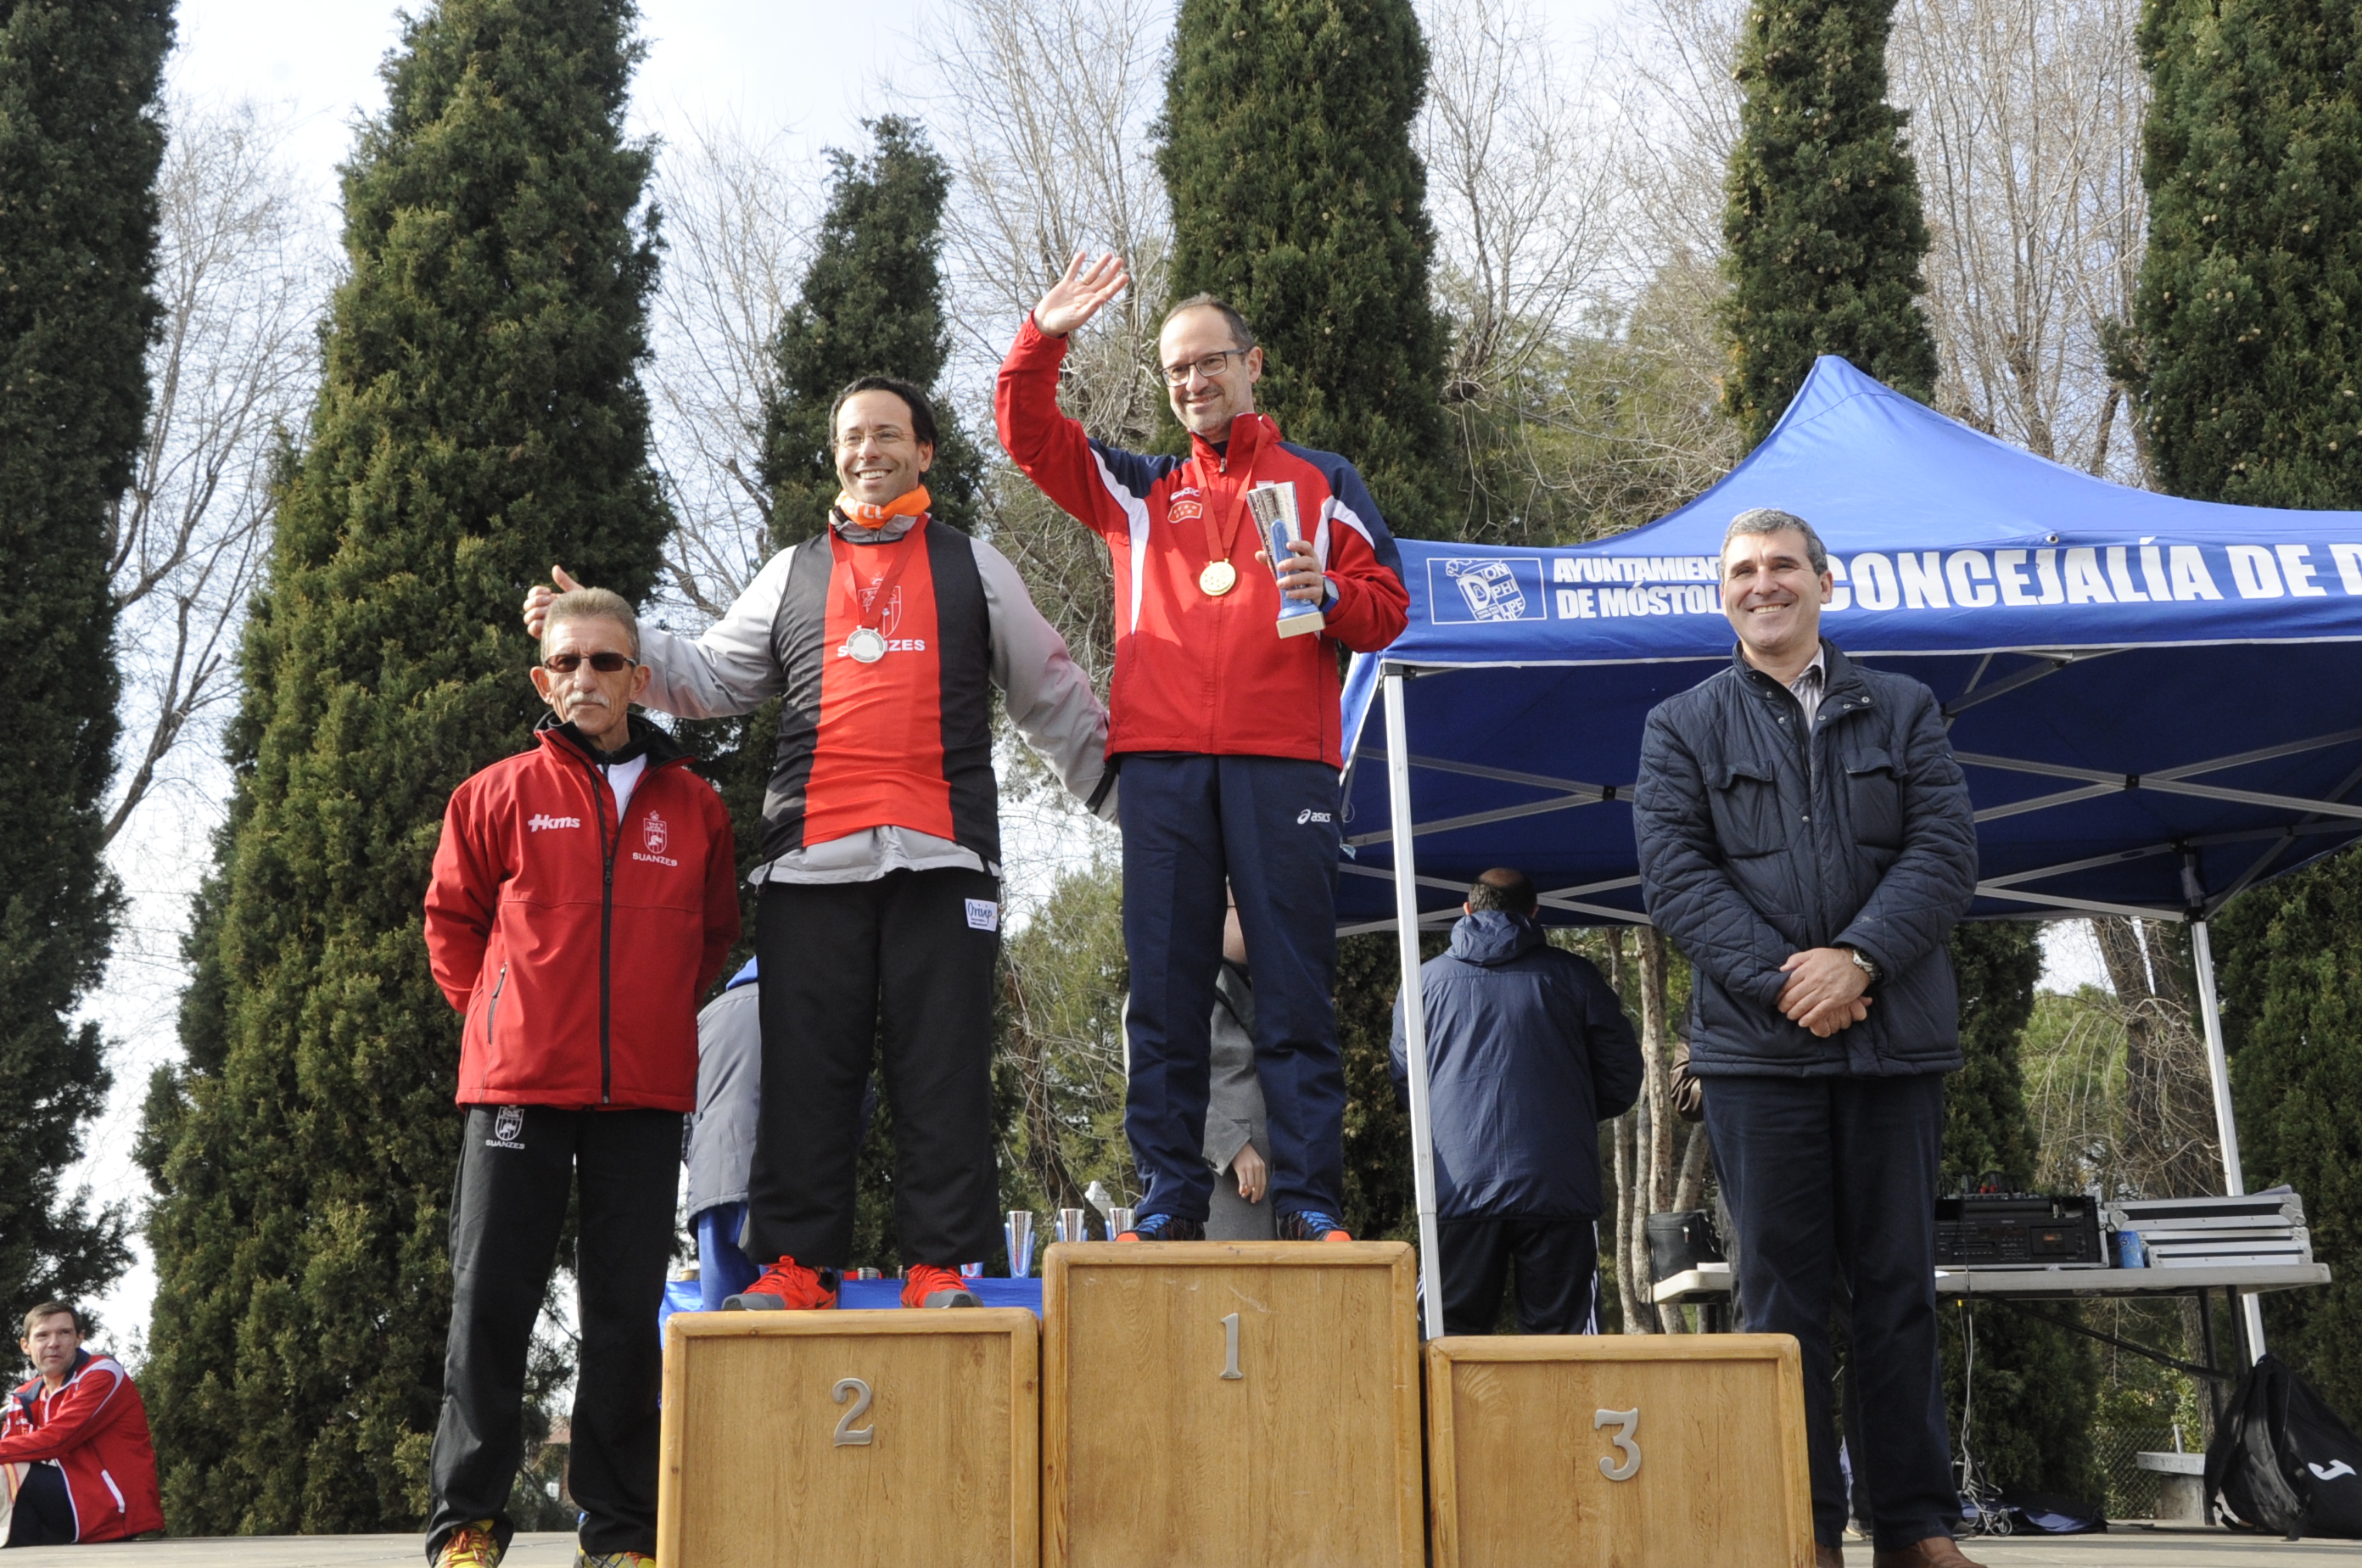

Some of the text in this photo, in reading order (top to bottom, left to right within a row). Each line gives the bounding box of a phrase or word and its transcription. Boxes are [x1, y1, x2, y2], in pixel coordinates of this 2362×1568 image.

[1553, 557, 1721, 583] AYUNTAMIEN
[2225, 544, 2327, 599] DE
[2328, 543, 2362, 596] D
[1556, 581, 1726, 619] DE MÓSTOL
[837, 639, 926, 657] SZES
[632, 852, 678, 866] SUANZES
[485, 1140, 525, 1150] SUANZES
[1220, 1313, 1244, 1380] 1
[832, 1378, 874, 1447] 2
[1594, 1407, 1642, 1481] 3
